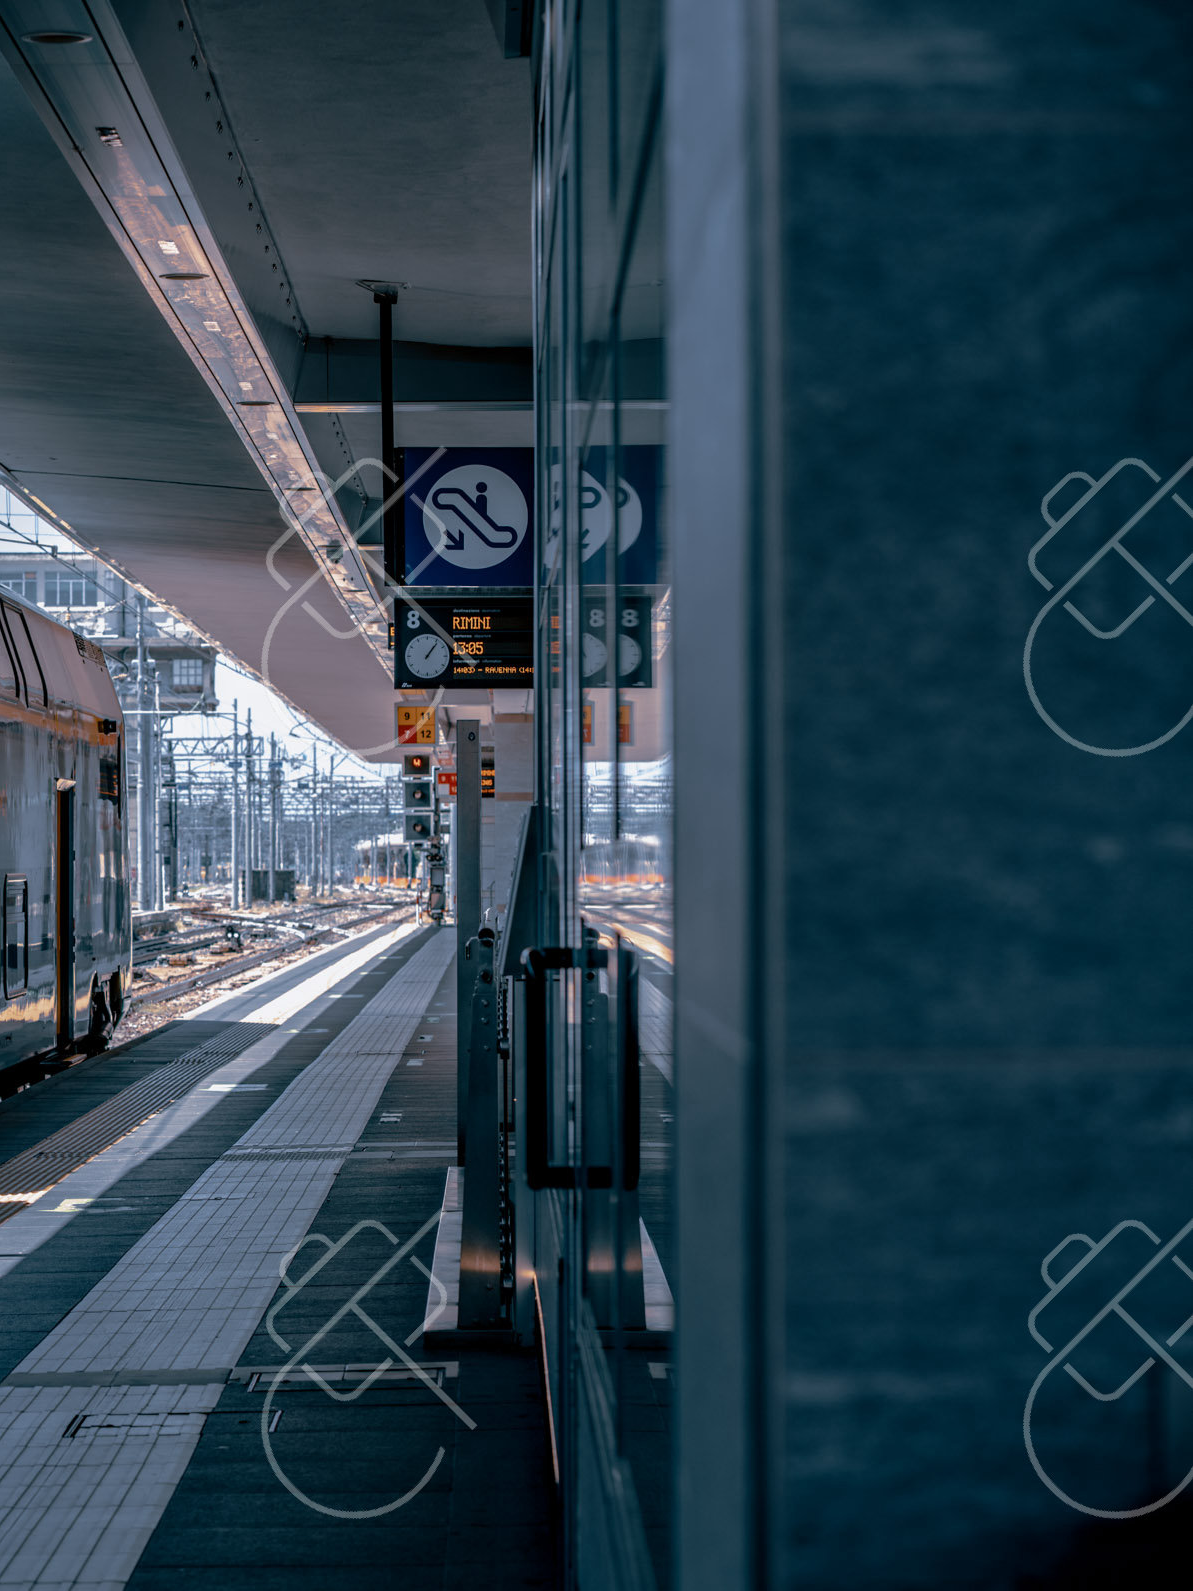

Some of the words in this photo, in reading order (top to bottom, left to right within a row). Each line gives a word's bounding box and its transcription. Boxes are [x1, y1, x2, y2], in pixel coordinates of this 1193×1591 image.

[407, 610, 420, 629] 8
[453, 616, 491, 630] RIMINI
[453, 641, 484, 655] 13:05
[485, 666, 517, 674] RAVENNA
[404, 712, 410, 720] 9
[421, 730, 431, 739] 12
